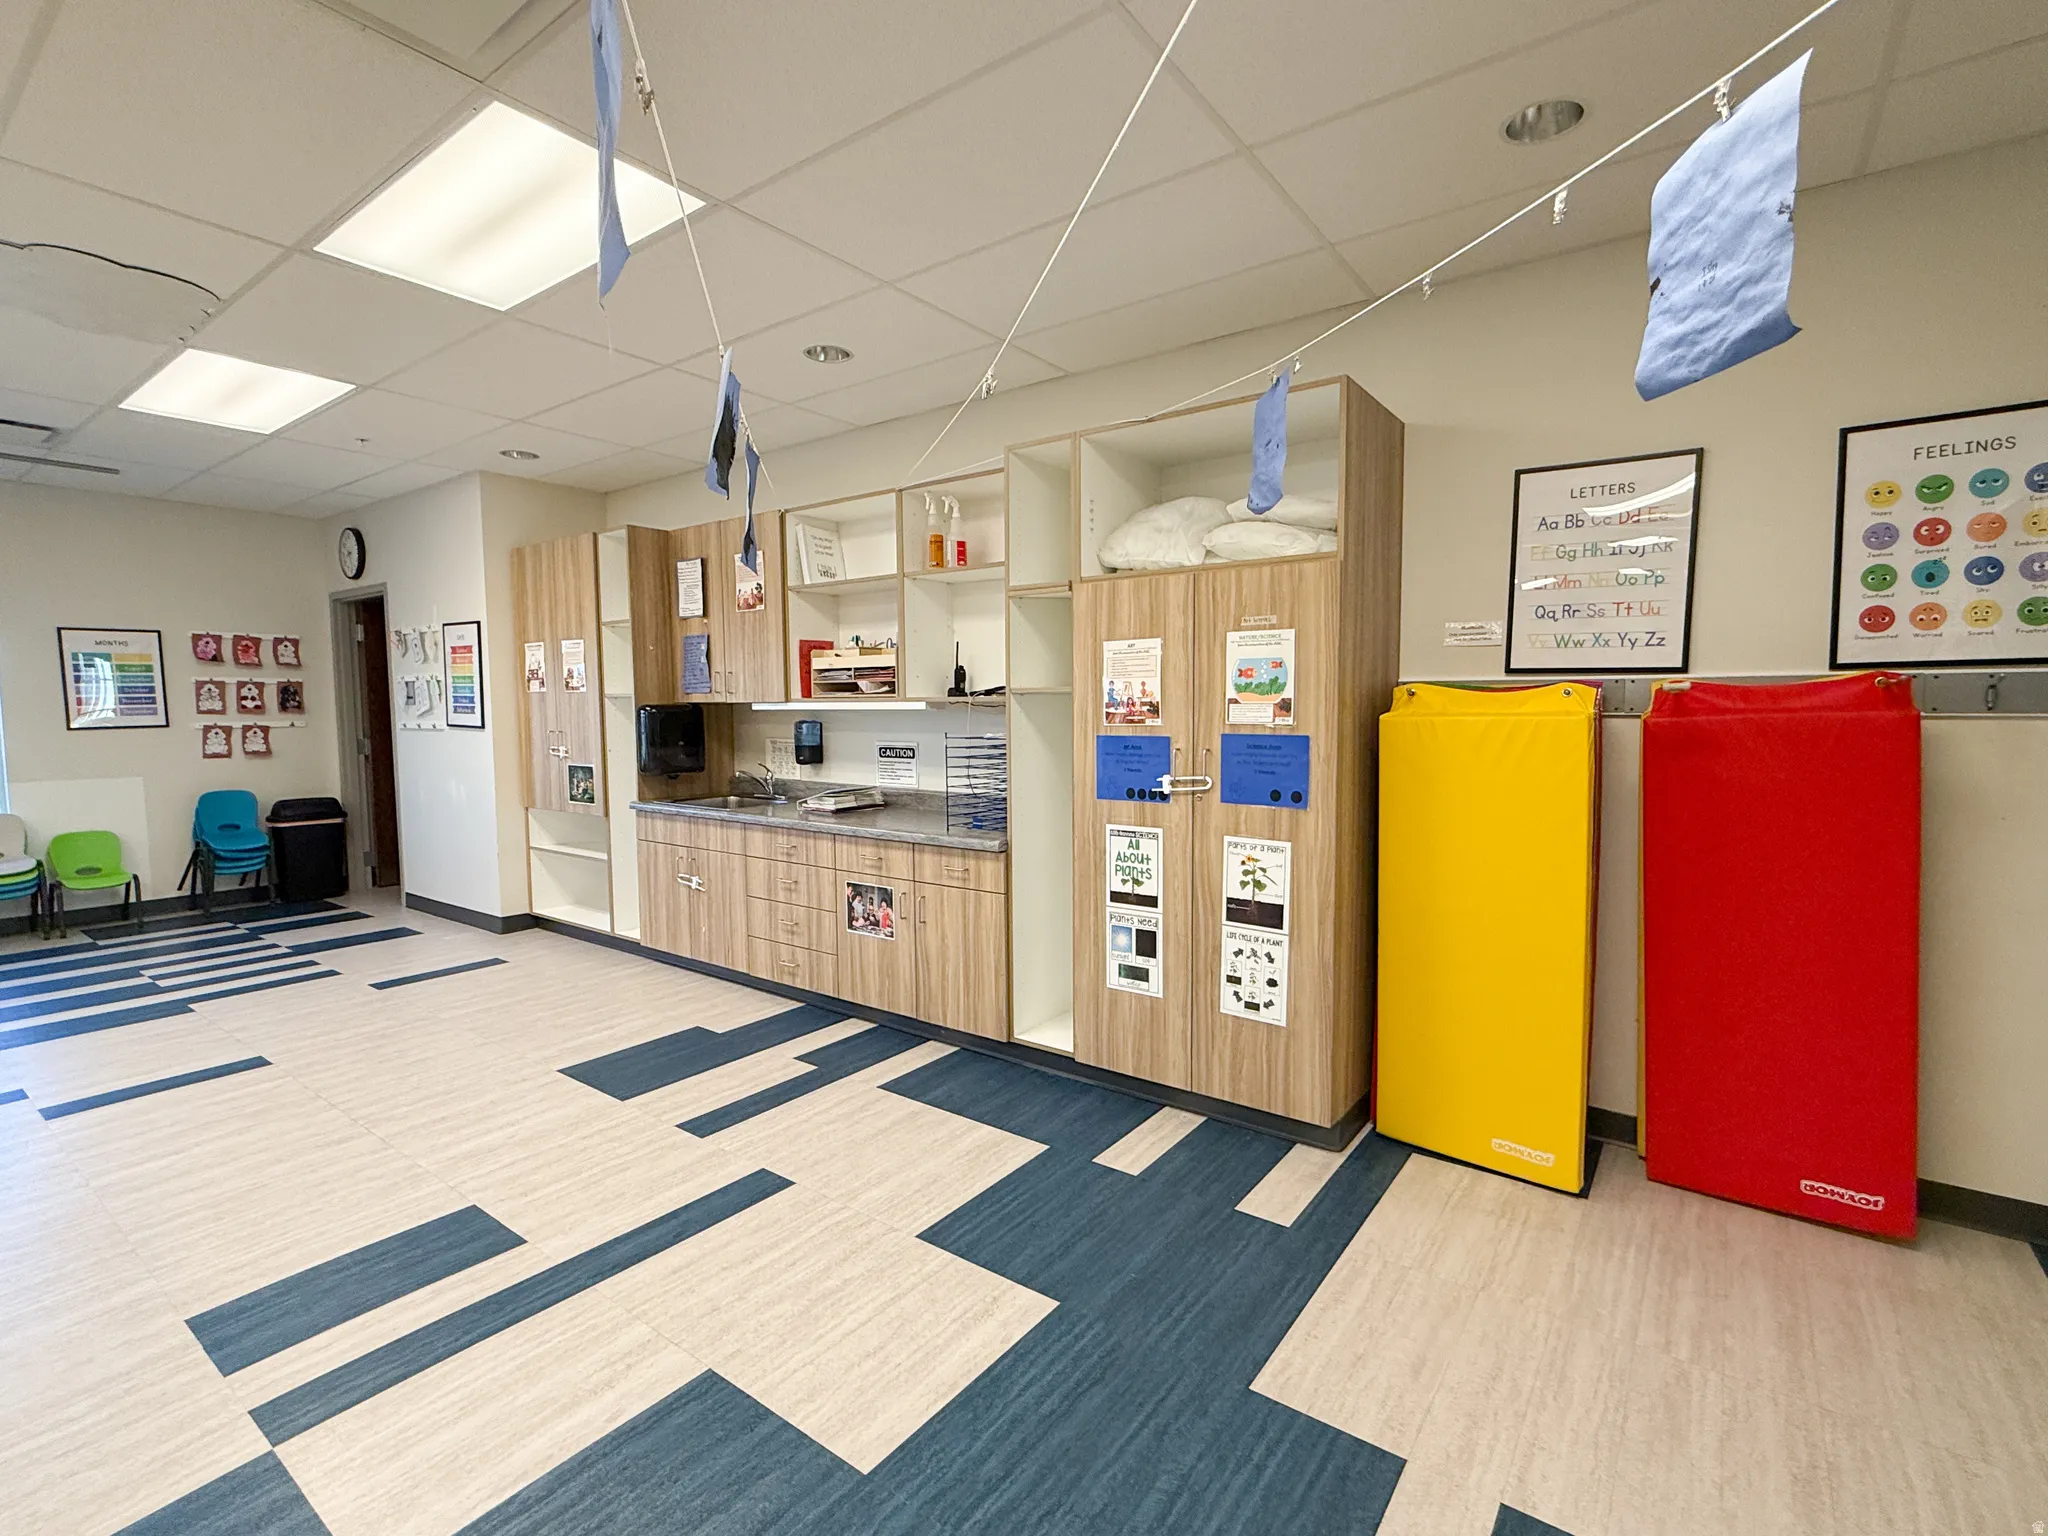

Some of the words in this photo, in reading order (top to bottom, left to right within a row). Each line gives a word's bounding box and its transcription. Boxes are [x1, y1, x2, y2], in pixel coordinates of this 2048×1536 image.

[1913, 436, 2017, 461] FEELINGS
[1570, 482, 1636, 499] LETTERS
[1537, 516, 1559, 531] Aa
[1564, 514, 1584, 529] Bb
[1618, 508, 1641, 525] Dd
[1556, 544, 1577, 562] Gg
[1582, 542, 1603, 558] Hh
[1553, 575, 1582, 589] Mm
[1644, 569, 1665, 588] Pp
[1535, 605, 1559, 622] Qq
[1561, 604, 1581, 618] Rr
[1586, 603, 1605, 618] Ss
[1612, 602, 1633, 617] Tt
[1639, 601, 1661, 616] Uu
[1527, 633, 1547, 648] Vv
[1554, 633, 1586, 648] Ww
[1592, 632, 1611, 647] Xx
[1617, 631, 1639, 650] Yy
[1645, 631, 1666, 647] Zz
[880, 748, 914, 758] CAUTION
[1127, 839, 1140, 850] All
[1115, 850, 1152, 865] About
[1115, 863, 1152, 880] Plants
[1226, 932, 1237, 940] LIFE
[1238, 934, 1252, 942] CYCLE
[1266, 939, 1283, 947] PLANT
[1493, 1140, 1551, 1164] JOYMOR
[1803, 1182, 1881, 1208] JOYMOR
